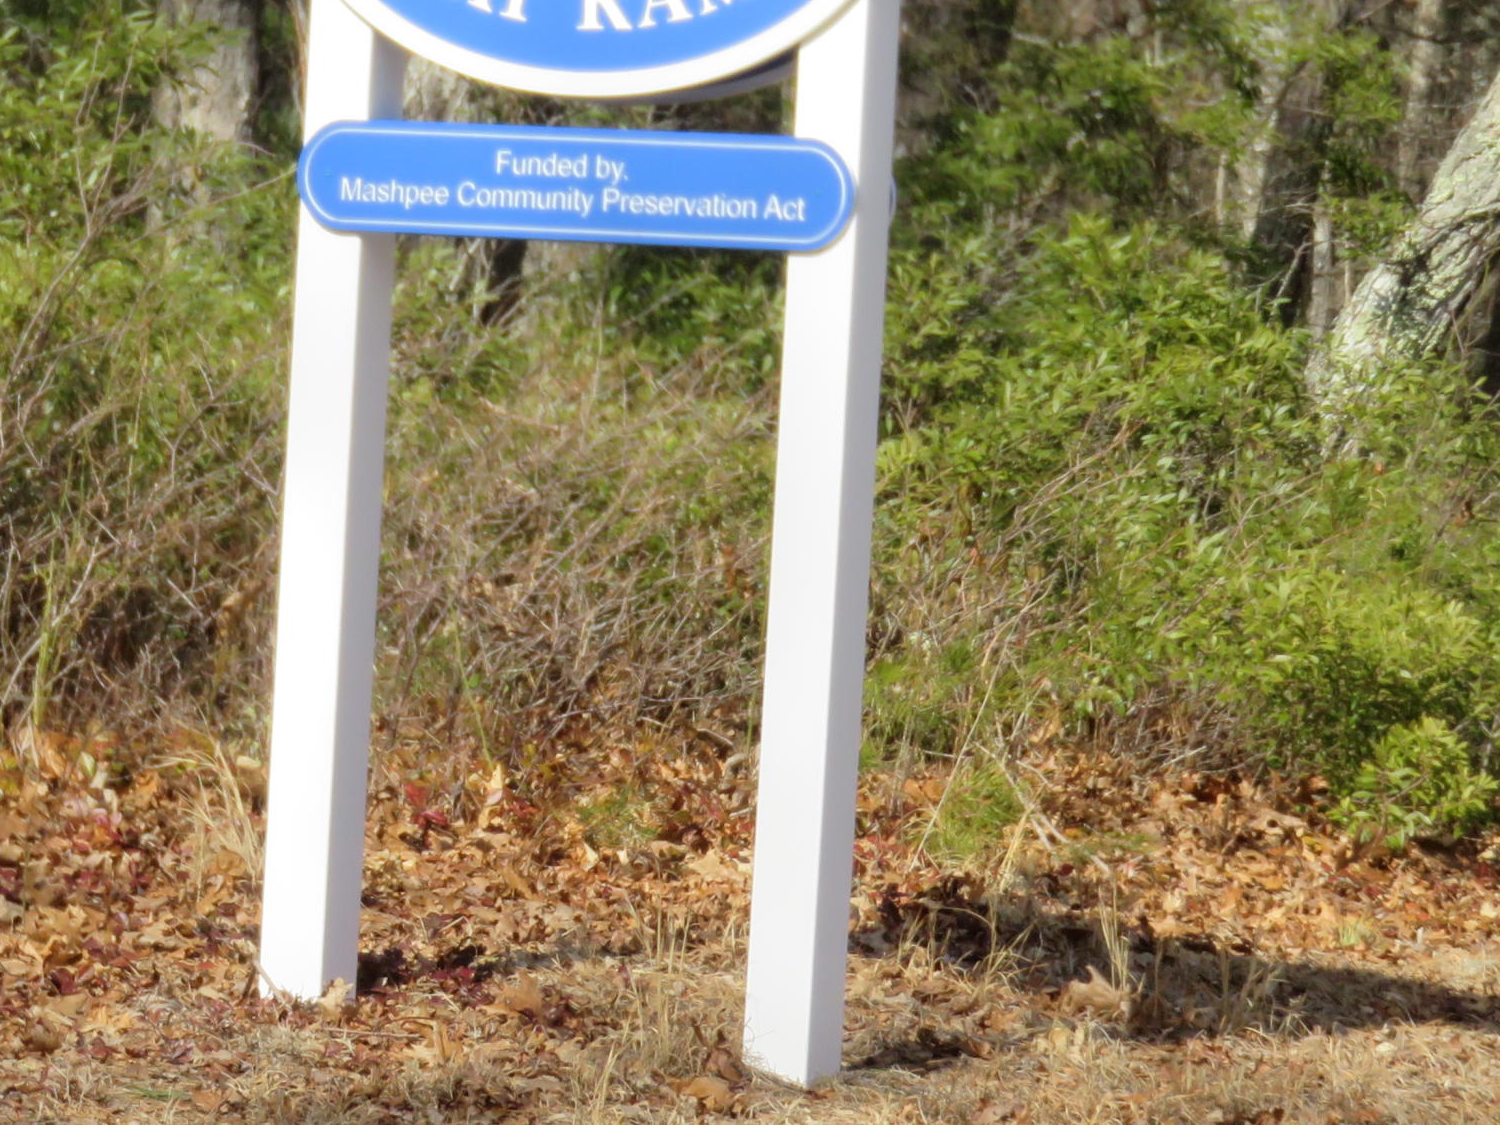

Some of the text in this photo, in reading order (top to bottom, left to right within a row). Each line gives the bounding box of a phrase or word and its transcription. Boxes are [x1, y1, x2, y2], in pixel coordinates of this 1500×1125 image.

[496, 150, 588, 178] Funded
[340, 178, 805, 222] Mashpee Community Preservation Act
